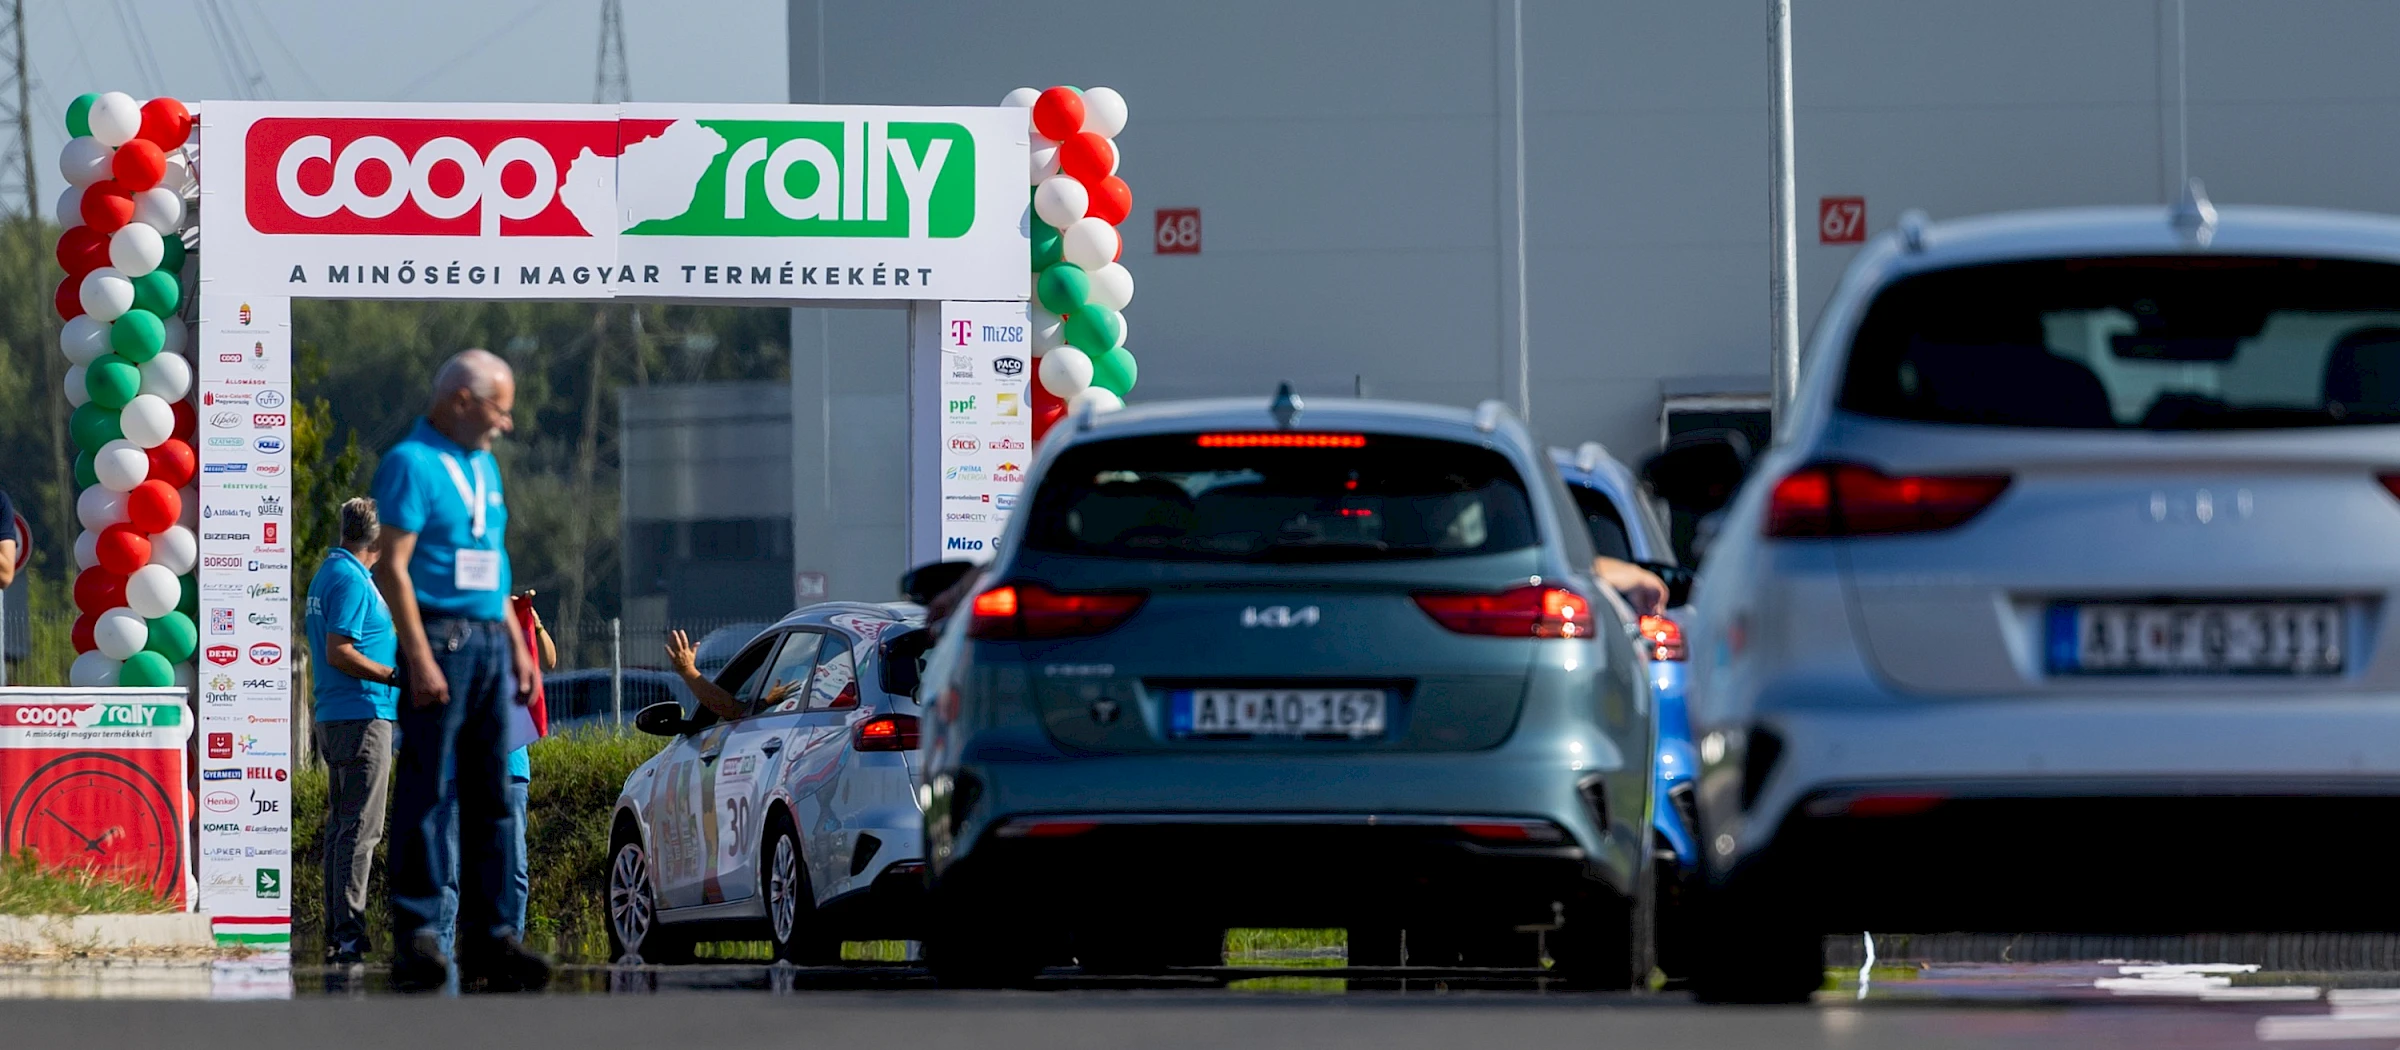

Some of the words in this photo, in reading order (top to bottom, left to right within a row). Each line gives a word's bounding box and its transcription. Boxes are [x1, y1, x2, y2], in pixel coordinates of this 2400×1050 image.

[276, 134, 558, 237] coop
[724, 121, 954, 239] rally
[1823, 203, 1861, 238] 67
[1159, 215, 1197, 247] 68
[290, 265, 307, 283] A
[328, 260, 500, 285] MINŐSÉGI
[520, 264, 660, 285] MAGYAR
[681, 260, 933, 286] TERMÉKEKÉRT
[996, 360, 1021, 370] PACO
[254, 415, 284, 426] coop
[952, 439, 977, 450] PICK
[993, 473, 1008, 482] Red
[240, 509, 251, 518] Tej
[257, 504, 284, 514] QUEEN
[204, 533, 250, 541] BIZERBA
[947, 537, 983, 550] Mizo
[204, 557, 242, 567] BORSODI
[208, 649, 236, 658] DETKI
[243, 679, 274, 688] FAAC
[205, 692, 238, 703] Dreher
[15, 706, 72, 728] coop
[108, 704, 157, 727] rally
[32, 730, 69, 739] minőségi
[102, 730, 153, 738] termékekért
[204, 769, 242, 779] GYERMELYI
[247, 767, 273, 779] HELL
[207, 797, 236, 805] Henkel
[252, 800, 279, 816] JDE
[203, 823, 240, 832] KOMETA
[726, 796, 750, 857] 30
